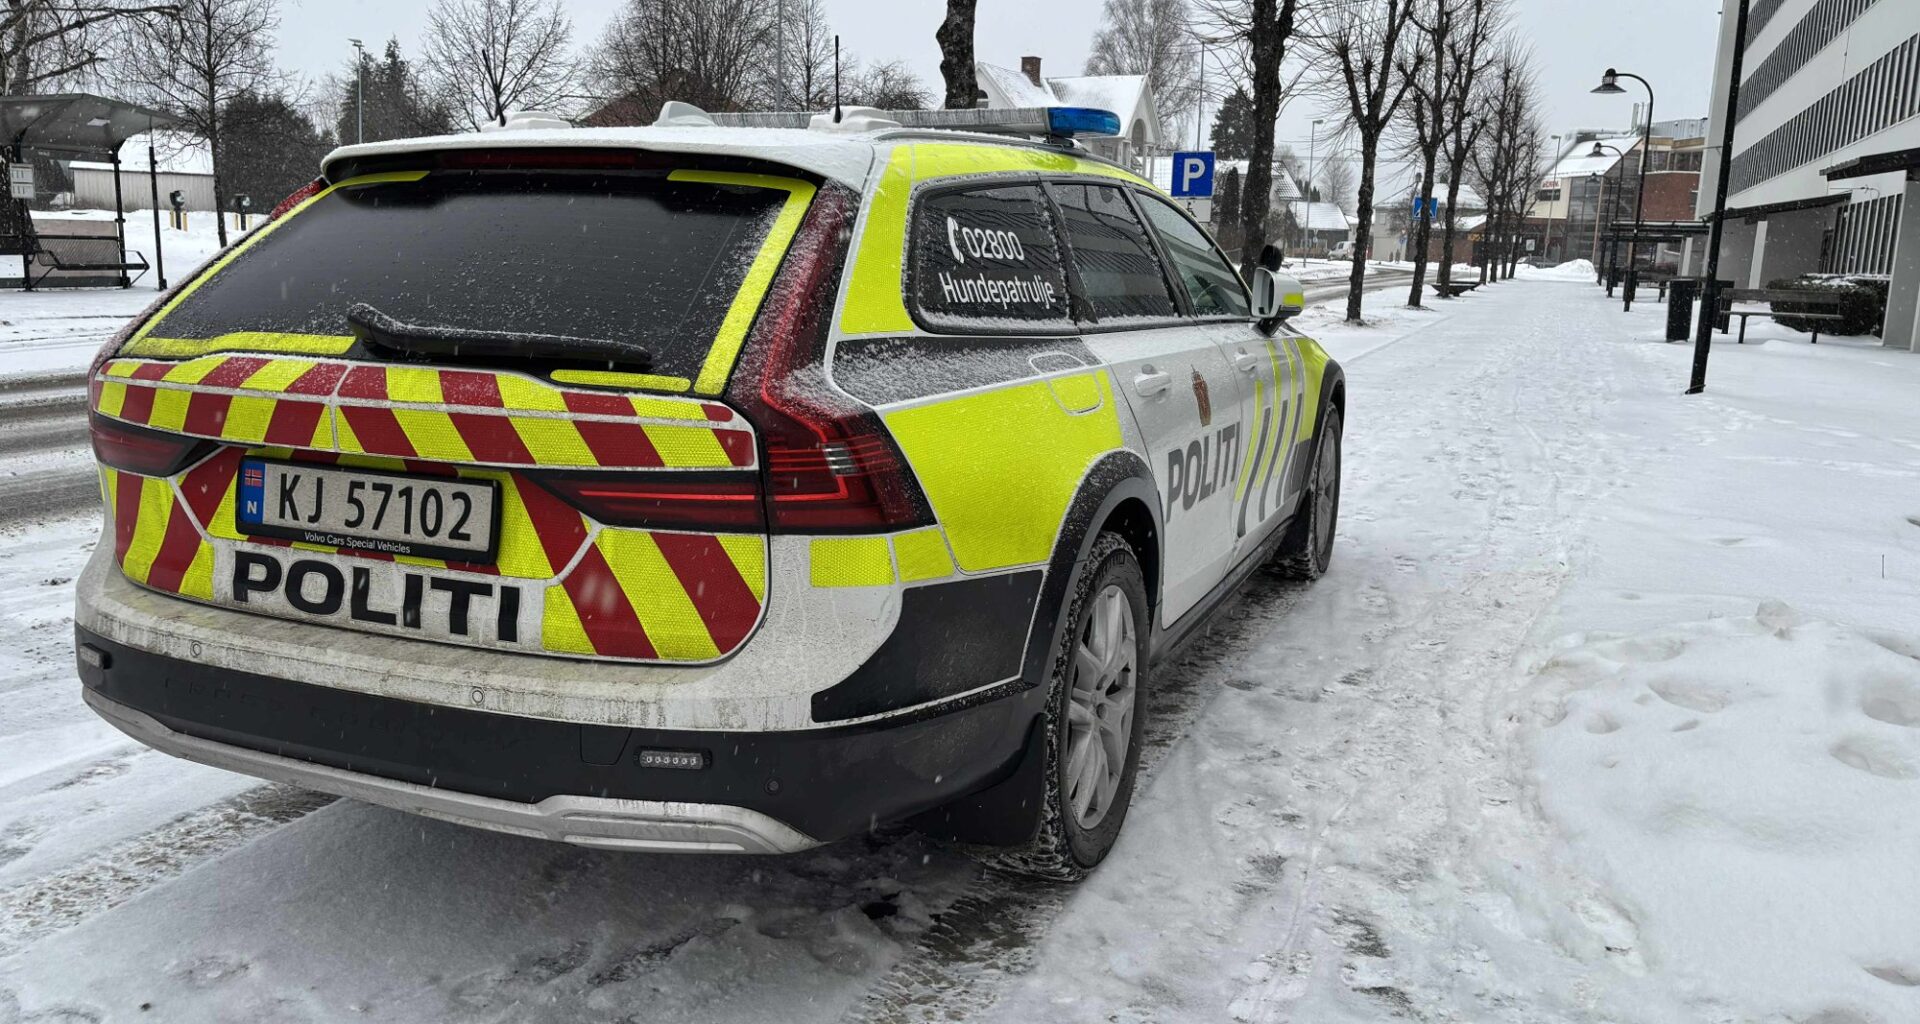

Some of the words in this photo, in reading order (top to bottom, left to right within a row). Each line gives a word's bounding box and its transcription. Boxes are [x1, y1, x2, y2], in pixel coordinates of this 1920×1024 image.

[1182, 158, 1205, 192] P
[962, 227, 1025, 261] 02800
[938, 272, 1057, 310] Hundepatrulje
[1166, 421, 1240, 524] POLITI
[247, 500, 257, 514] N
[278, 473, 323, 523] KJ
[345, 481, 471, 541] 57102
[304, 532, 325, 543] Volvo
[327, 535, 345, 546] Cars
[346, 537, 376, 550] Special
[377, 541, 411, 554] Vehicles
[233, 550, 520, 642] POLITI
